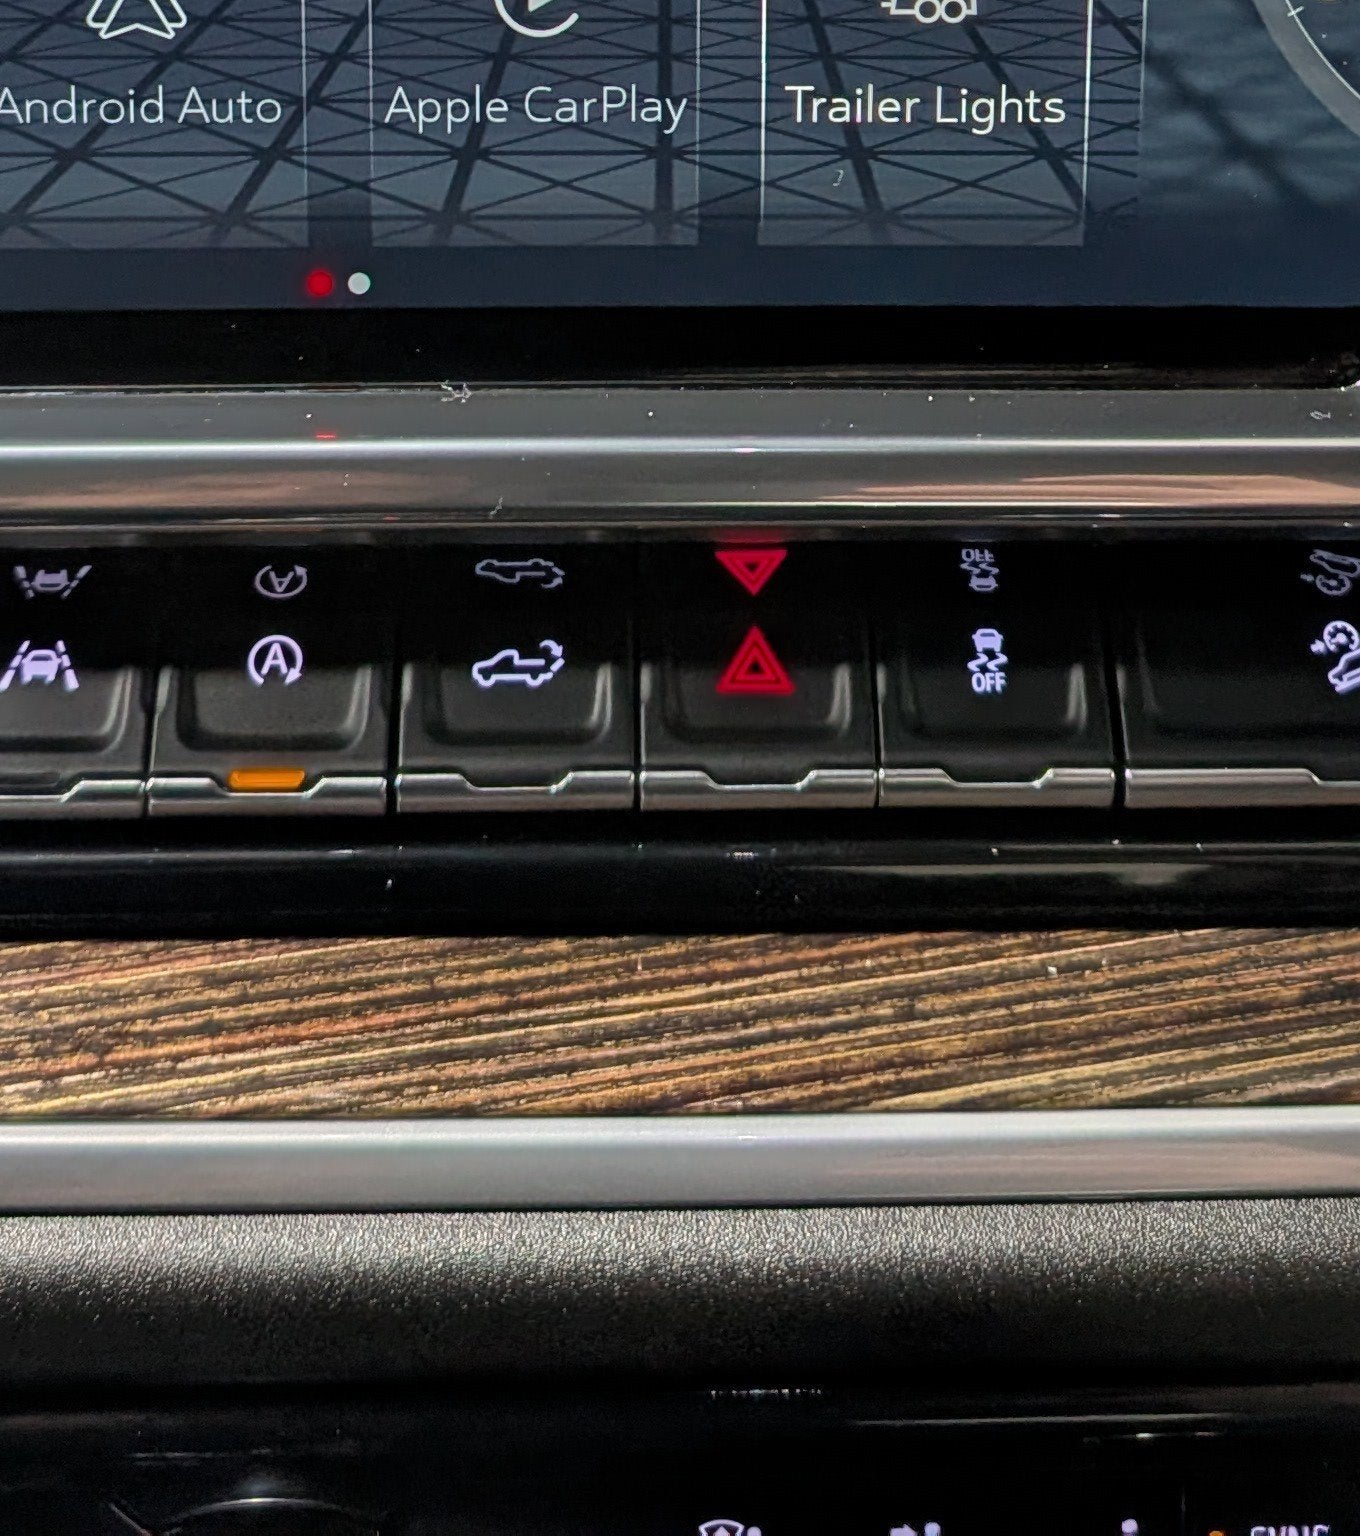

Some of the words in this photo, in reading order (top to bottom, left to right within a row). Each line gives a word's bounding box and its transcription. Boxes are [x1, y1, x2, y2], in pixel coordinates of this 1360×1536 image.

[176, 85, 283, 125] Auto
[383, 82, 510, 135] Apple
[523, 82, 690, 136] CarPlay
[783, 82, 922, 124] Trailer
[934, 82, 1067, 136] Lights
[260, 642, 289, 676] A
[970, 671, 1009, 694] OFF
